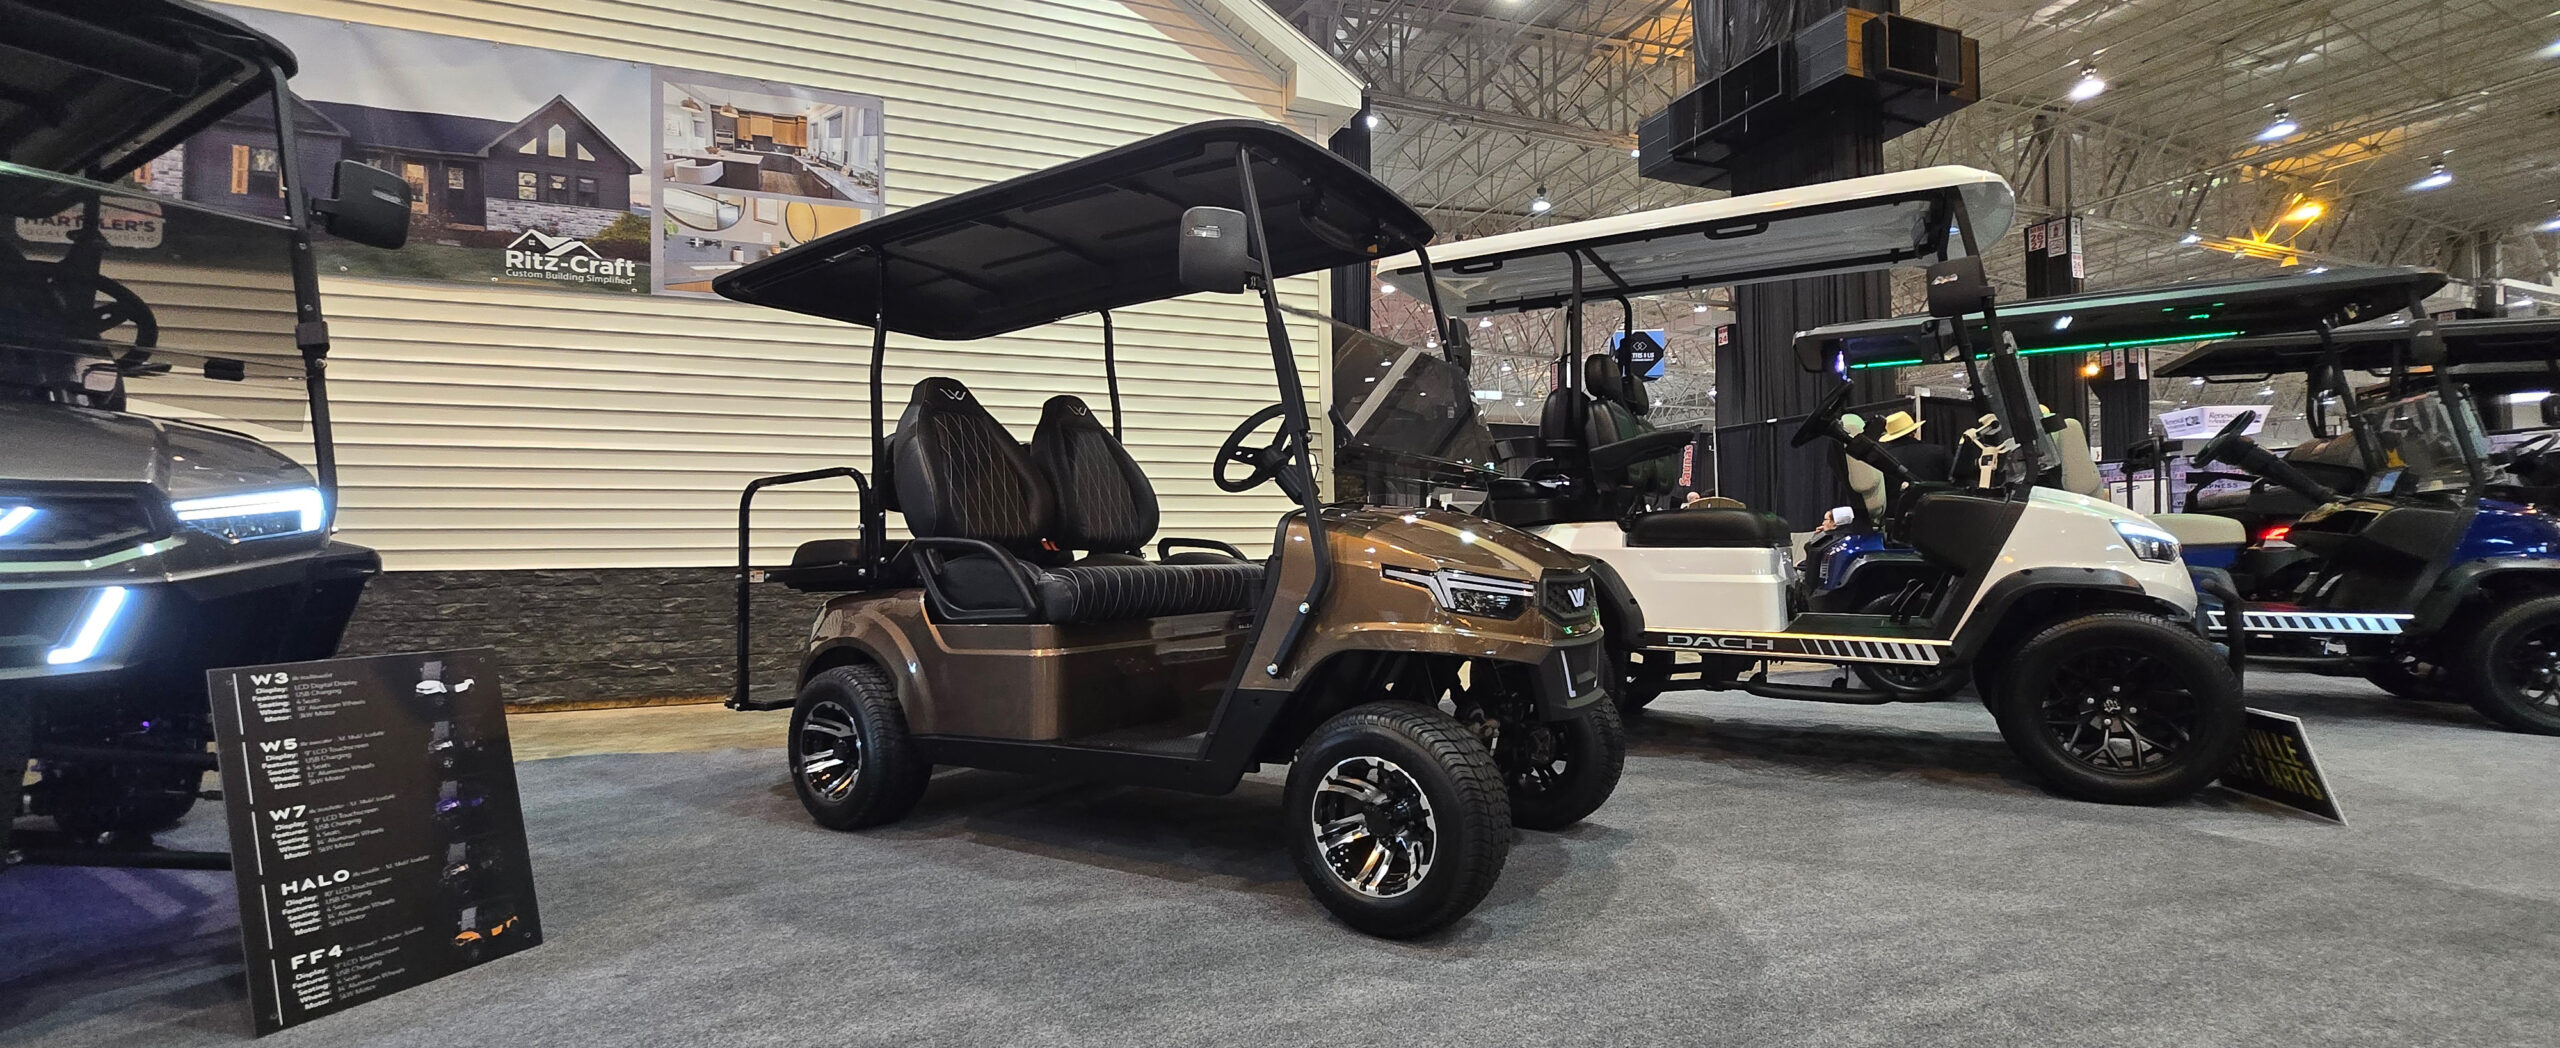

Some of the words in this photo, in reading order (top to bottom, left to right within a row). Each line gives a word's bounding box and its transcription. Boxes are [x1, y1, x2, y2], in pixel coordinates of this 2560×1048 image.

[506, 250, 635, 277] Ritz-Craft
[506, 269, 543, 278] Custom
[546, 271, 585, 283] Building
[587, 274, 632, 285] Simplified
[1679, 445, 1694, 487] Saunas
[1667, 634, 1774, 650] DACH
[250, 672, 289, 686] W3
[259, 738, 298, 752] W5
[269, 805, 306, 821] W7
[281, 869, 350, 896] HALO
[291, 944, 343, 970] FF4
